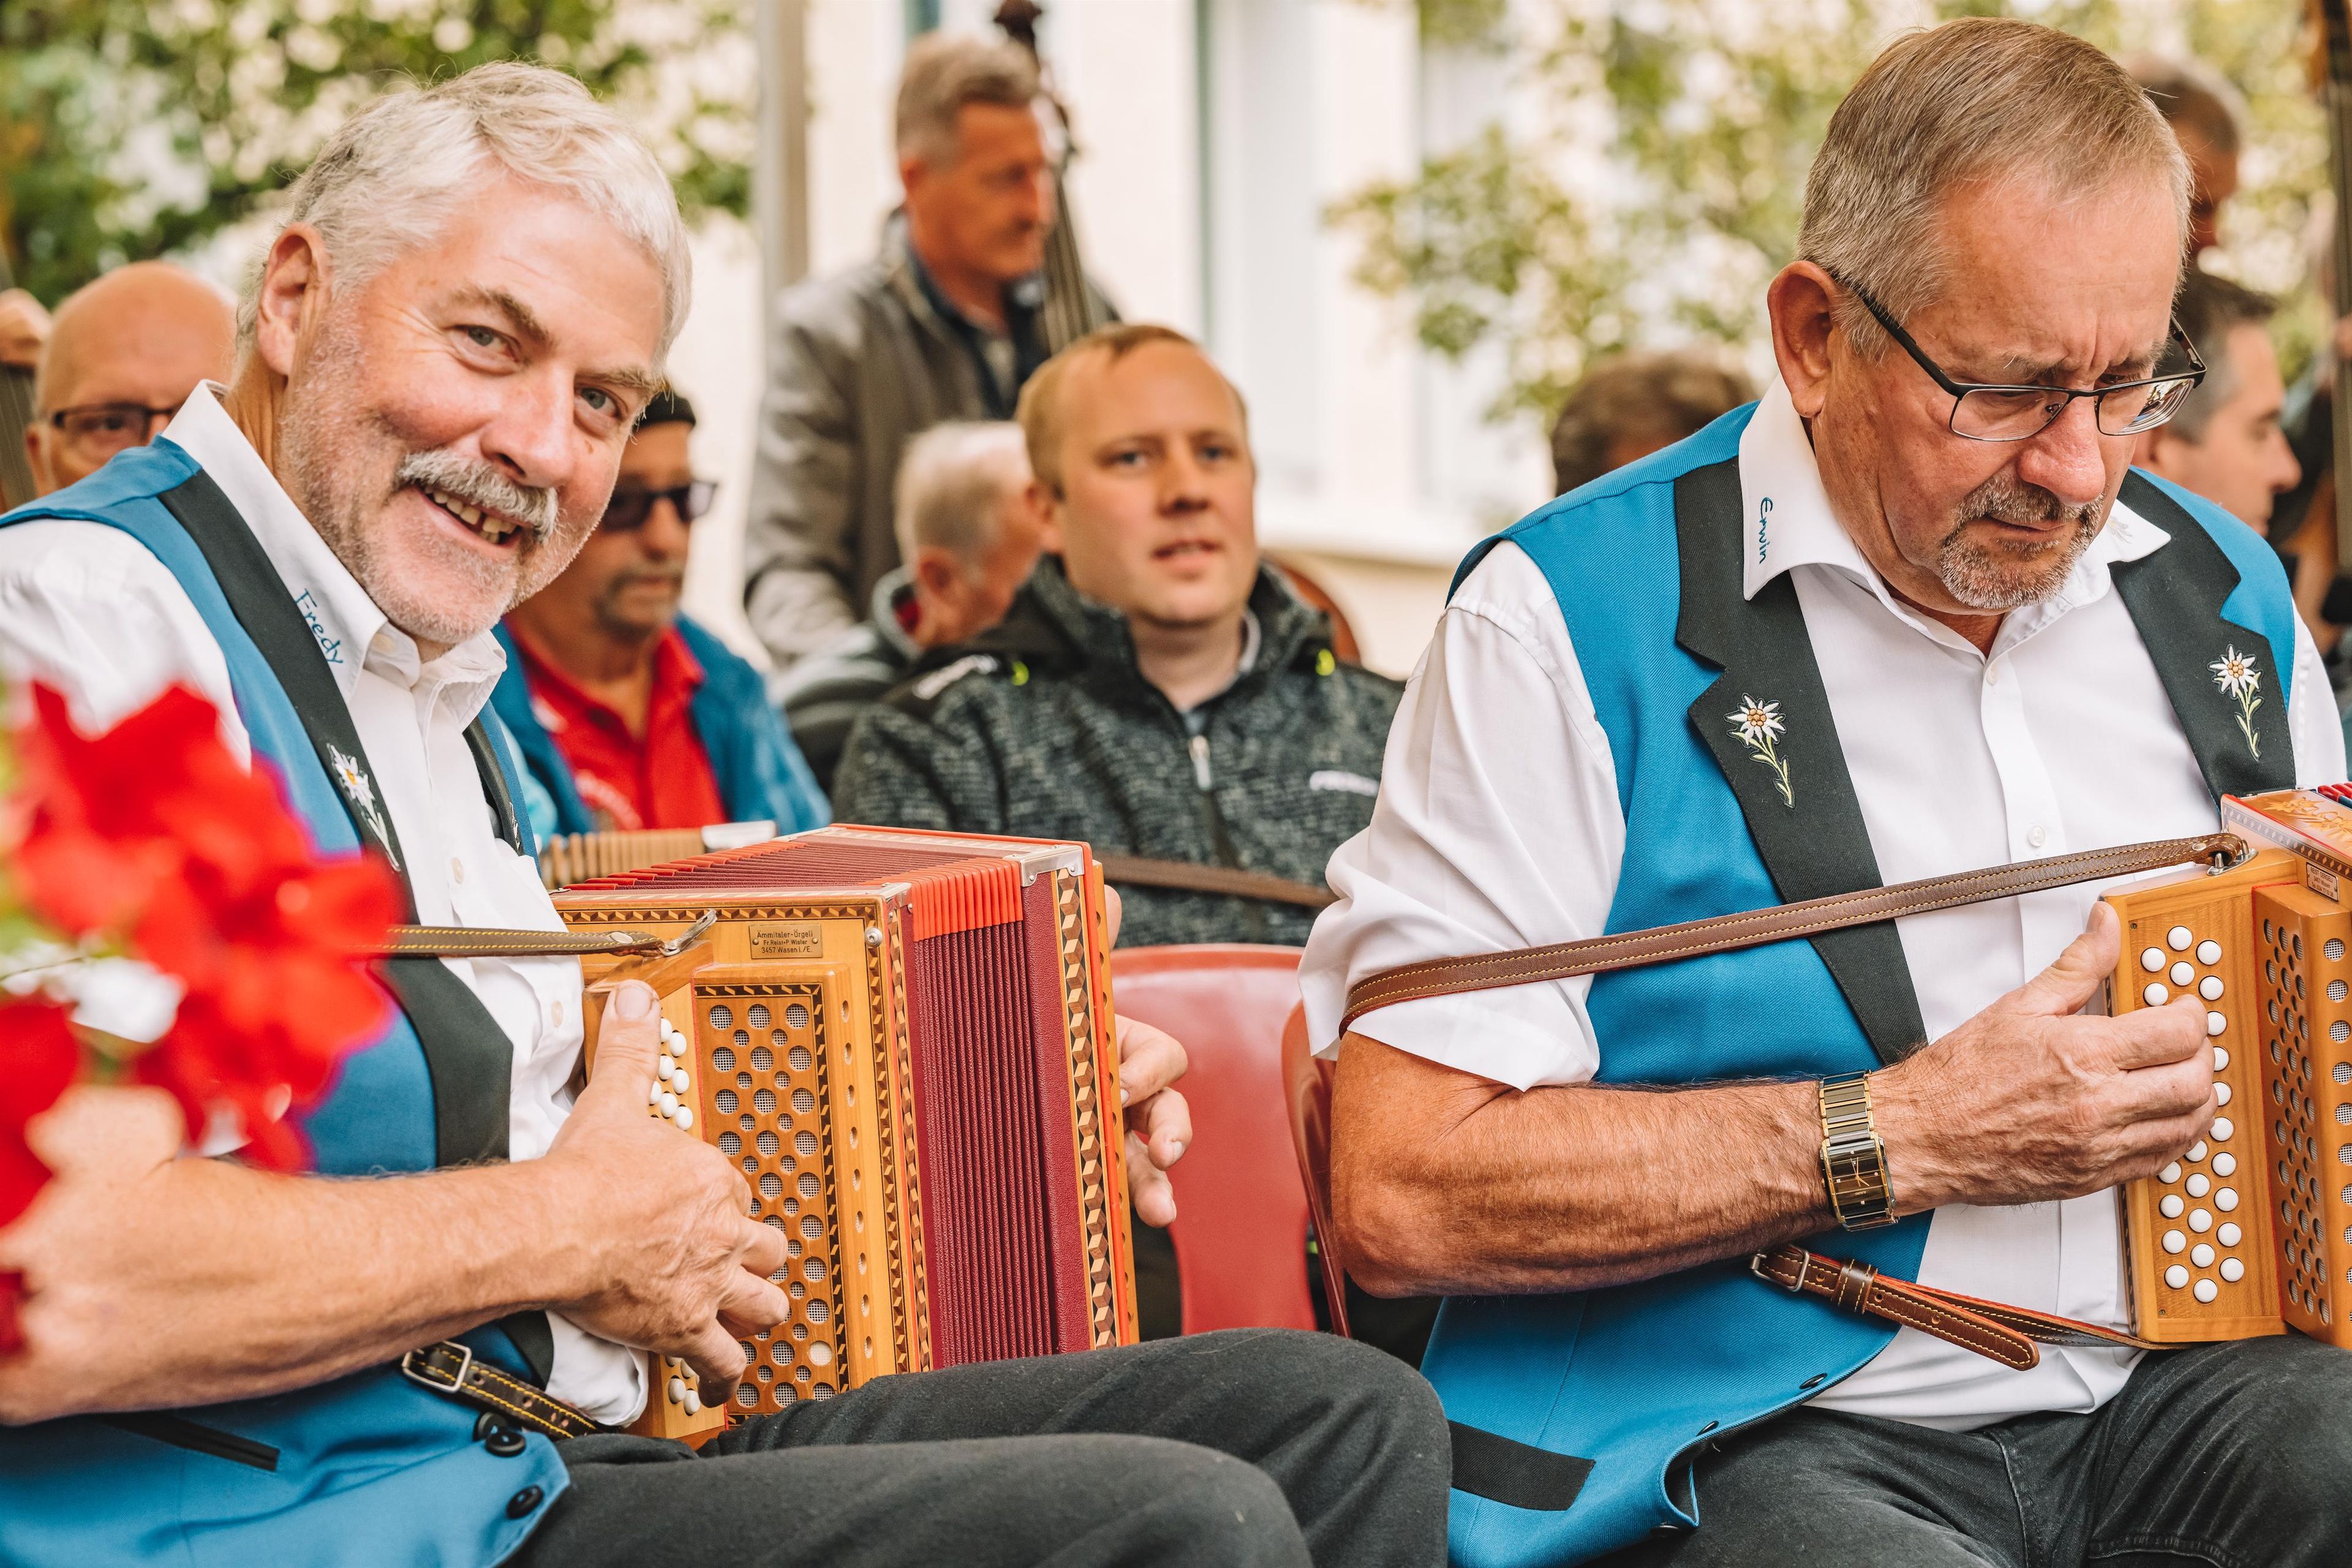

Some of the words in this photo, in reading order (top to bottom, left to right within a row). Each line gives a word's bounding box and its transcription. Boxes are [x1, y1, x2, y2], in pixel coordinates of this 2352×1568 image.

[1758, 497, 1773, 564] Erwin
[295, 588, 344, 663] Fredy
[757, 929, 813, 938] Ämmitaler-Örgeli
